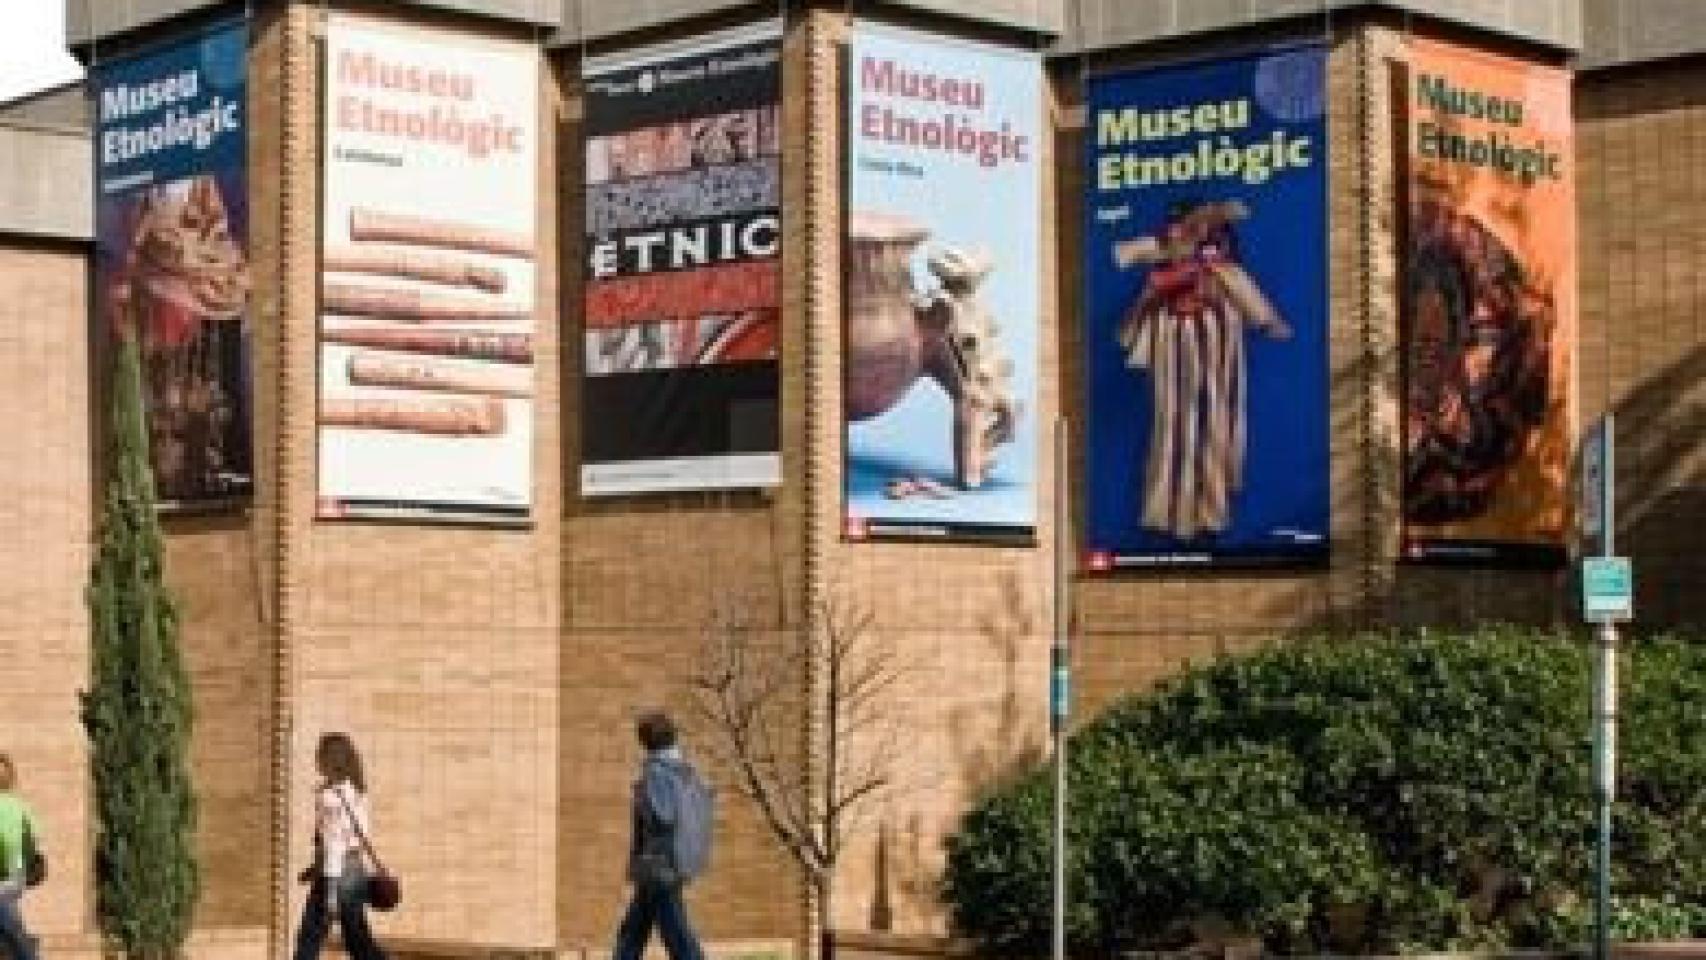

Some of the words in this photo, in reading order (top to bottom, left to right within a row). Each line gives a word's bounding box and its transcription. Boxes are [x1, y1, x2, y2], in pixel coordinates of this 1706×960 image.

[104, 70, 198, 119] Museu
[336, 47, 473, 100] Museu
[860, 56, 984, 109] Museu
[1416, 74, 1524, 127] Museu
[103, 96, 239, 163] Etnològic
[336, 96, 524, 157] Etnològic
[860, 104, 1030, 167] Etnològic
[1097, 98, 1249, 145] Museu
[1097, 131, 1312, 189] Etnològic
[1416, 121, 1563, 185] Etnològic
